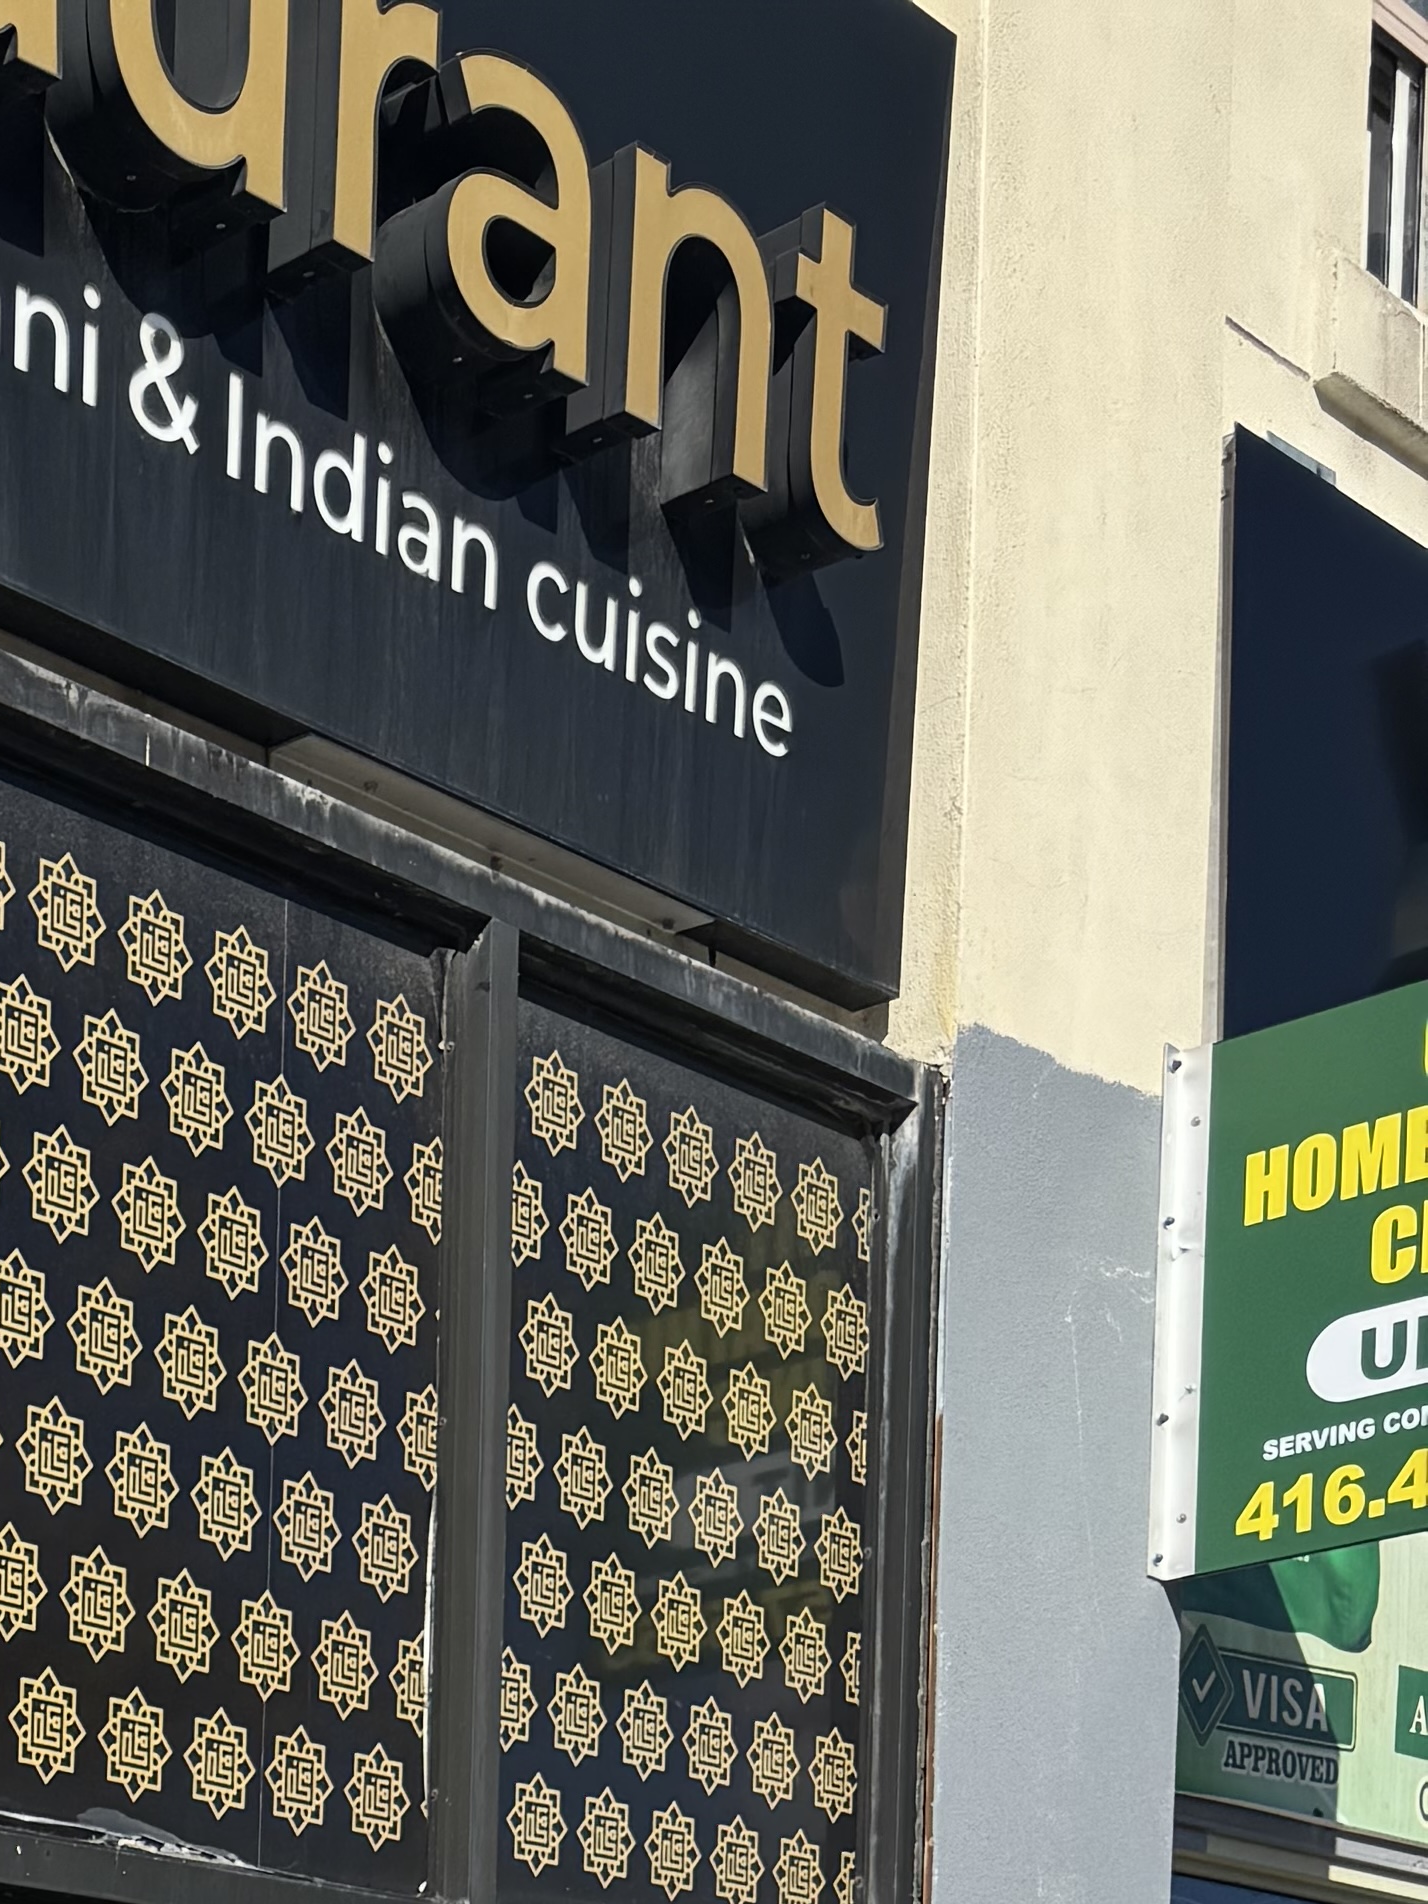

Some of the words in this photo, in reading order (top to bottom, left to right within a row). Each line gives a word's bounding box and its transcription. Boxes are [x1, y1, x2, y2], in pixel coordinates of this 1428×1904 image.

[128, 311, 201, 457] &
[225, 371, 501, 611] Indian
[525, 559, 795, 760] cuisine
[1262, 1417, 1376, 1461] SERVING
[1383, 1405, 1428, 1434] CO
[1235, 1448, 1428, 1541] 416.4
[1242, 1669, 1329, 1733] VISA
[1223, 1739, 1339, 1786] APPROVED
